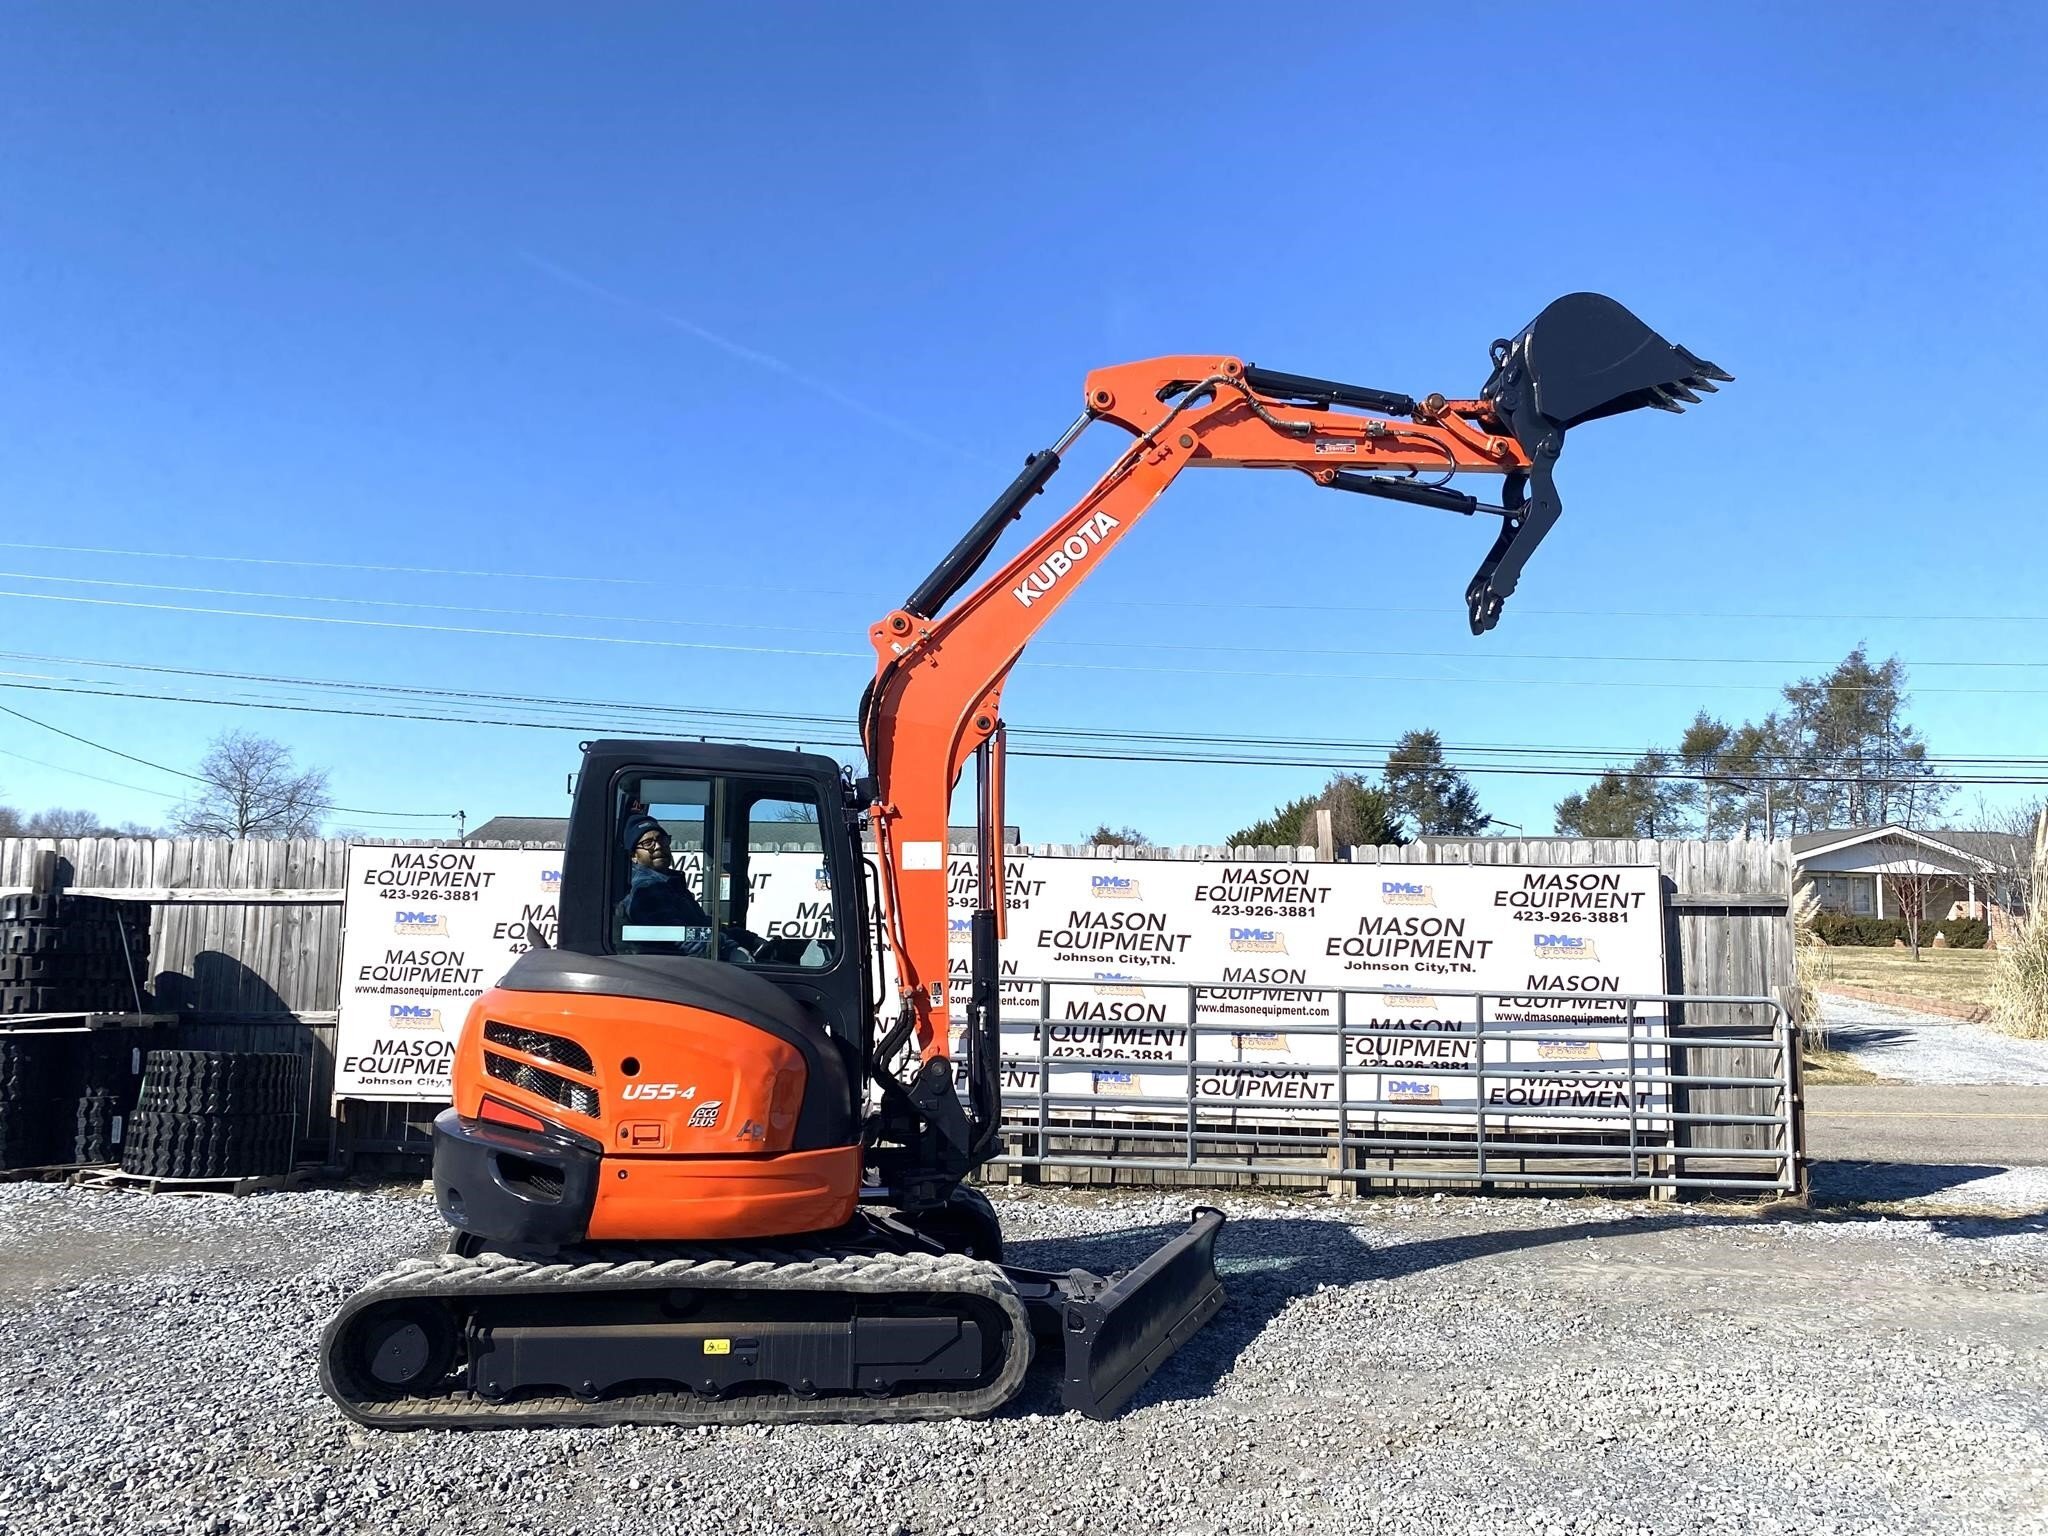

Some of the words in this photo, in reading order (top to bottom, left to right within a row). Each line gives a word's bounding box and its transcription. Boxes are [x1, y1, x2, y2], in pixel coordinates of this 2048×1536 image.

[1012, 511, 1120, 608] KUBOTA
[391, 853, 476, 870] MASON
[363, 869, 496, 888] EQUIPMENT
[1222, 868, 1309, 885] MASON
[1523, 873, 1620, 890] MASON
[379, 889, 479, 901] 423-926-3881
[1194, 886, 1332, 904] EQUIPMENT
[1493, 890, 1646, 909] EQUIPMENT
[1212, 905, 1316, 918] 423-926-3881
[1513, 910, 1628, 923] 423-926-3881
[1068, 910, 1167, 931] MASON
[1358, 916, 1465, 937] MASON
[1037, 930, 1192, 952] EQUIPMENT
[1325, 937, 1493, 959] EQUIPMENT
[385, 949, 465, 966] MASON
[1053, 952, 1114, 963] Johnson
[1344, 960, 1409, 972] Johnson
[359, 965, 484, 983] EQUIPMENT
[1222, 967, 1306, 984] MASON
[354, 984, 484, 997] www.dmasonequipment.com
[1527, 975, 1619, 992] MASON
[1065, 1001, 1167, 1022] MASON
[1495, 1011, 1646, 1025] www.dmasonequipment.cm
[1370, 1018, 1462, 1032] MASON
[343, 1056, 452, 1075] EQUIPME
[357, 1076, 412, 1086] Johnson
[622, 1083, 696, 1100] U55-4
[1489, 1088, 1652, 1109] EQUIPMENT
[687, 1117, 717, 1128] PLUS
